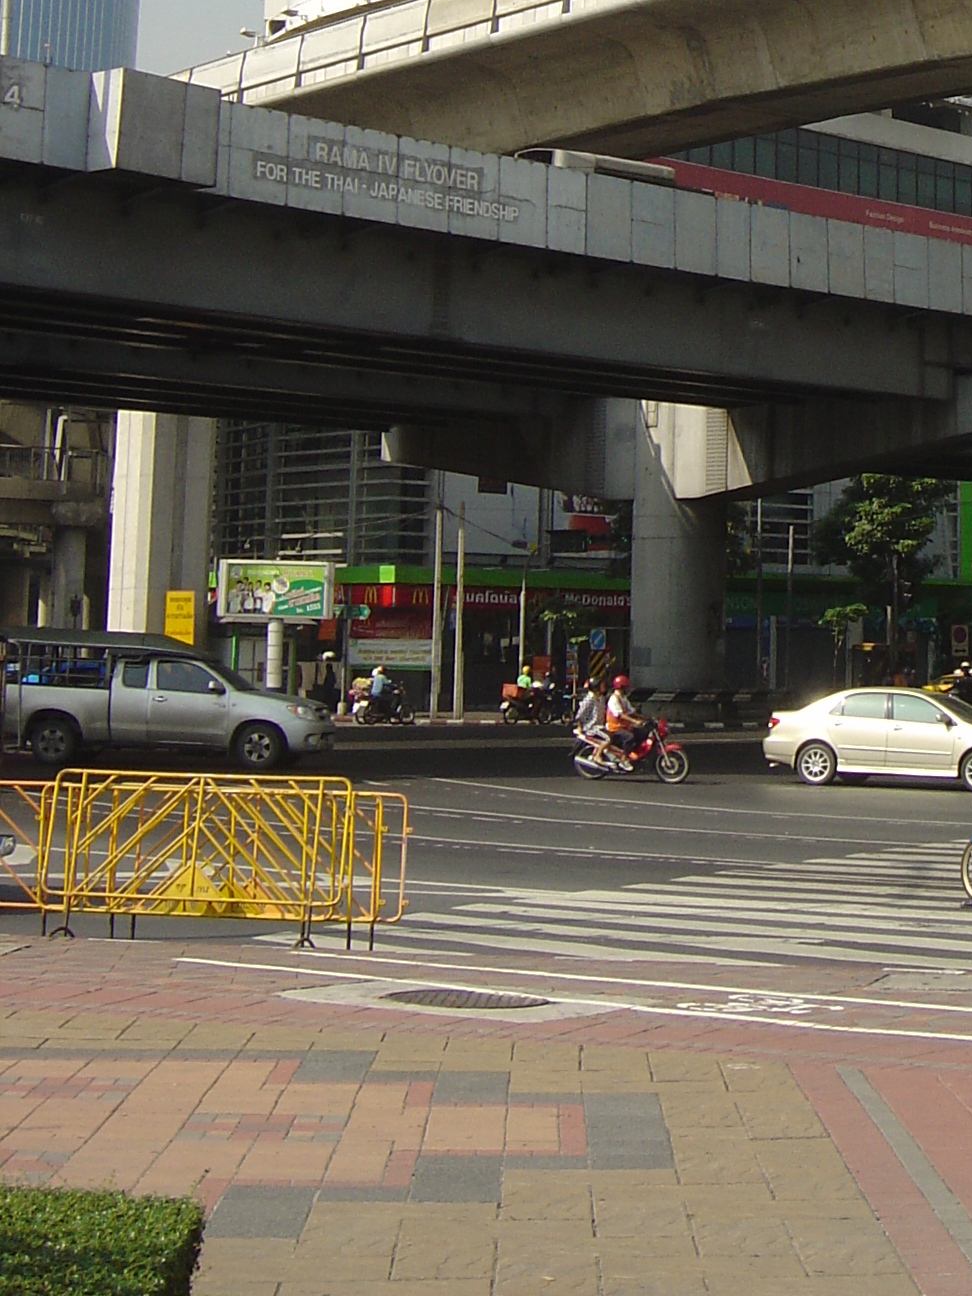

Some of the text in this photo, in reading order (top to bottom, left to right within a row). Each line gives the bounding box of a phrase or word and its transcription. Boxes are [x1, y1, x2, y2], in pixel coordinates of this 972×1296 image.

[256, 160, 288, 182] FOR
[292, 167, 321, 188] THE
[325, 173, 358, 194] THAI
[370, 181, 443, 210] JAPANESE
[446, 195, 519, 222] FRIENDSHIP
[315, 142, 479, 191] RAMA IV FLYOVER
